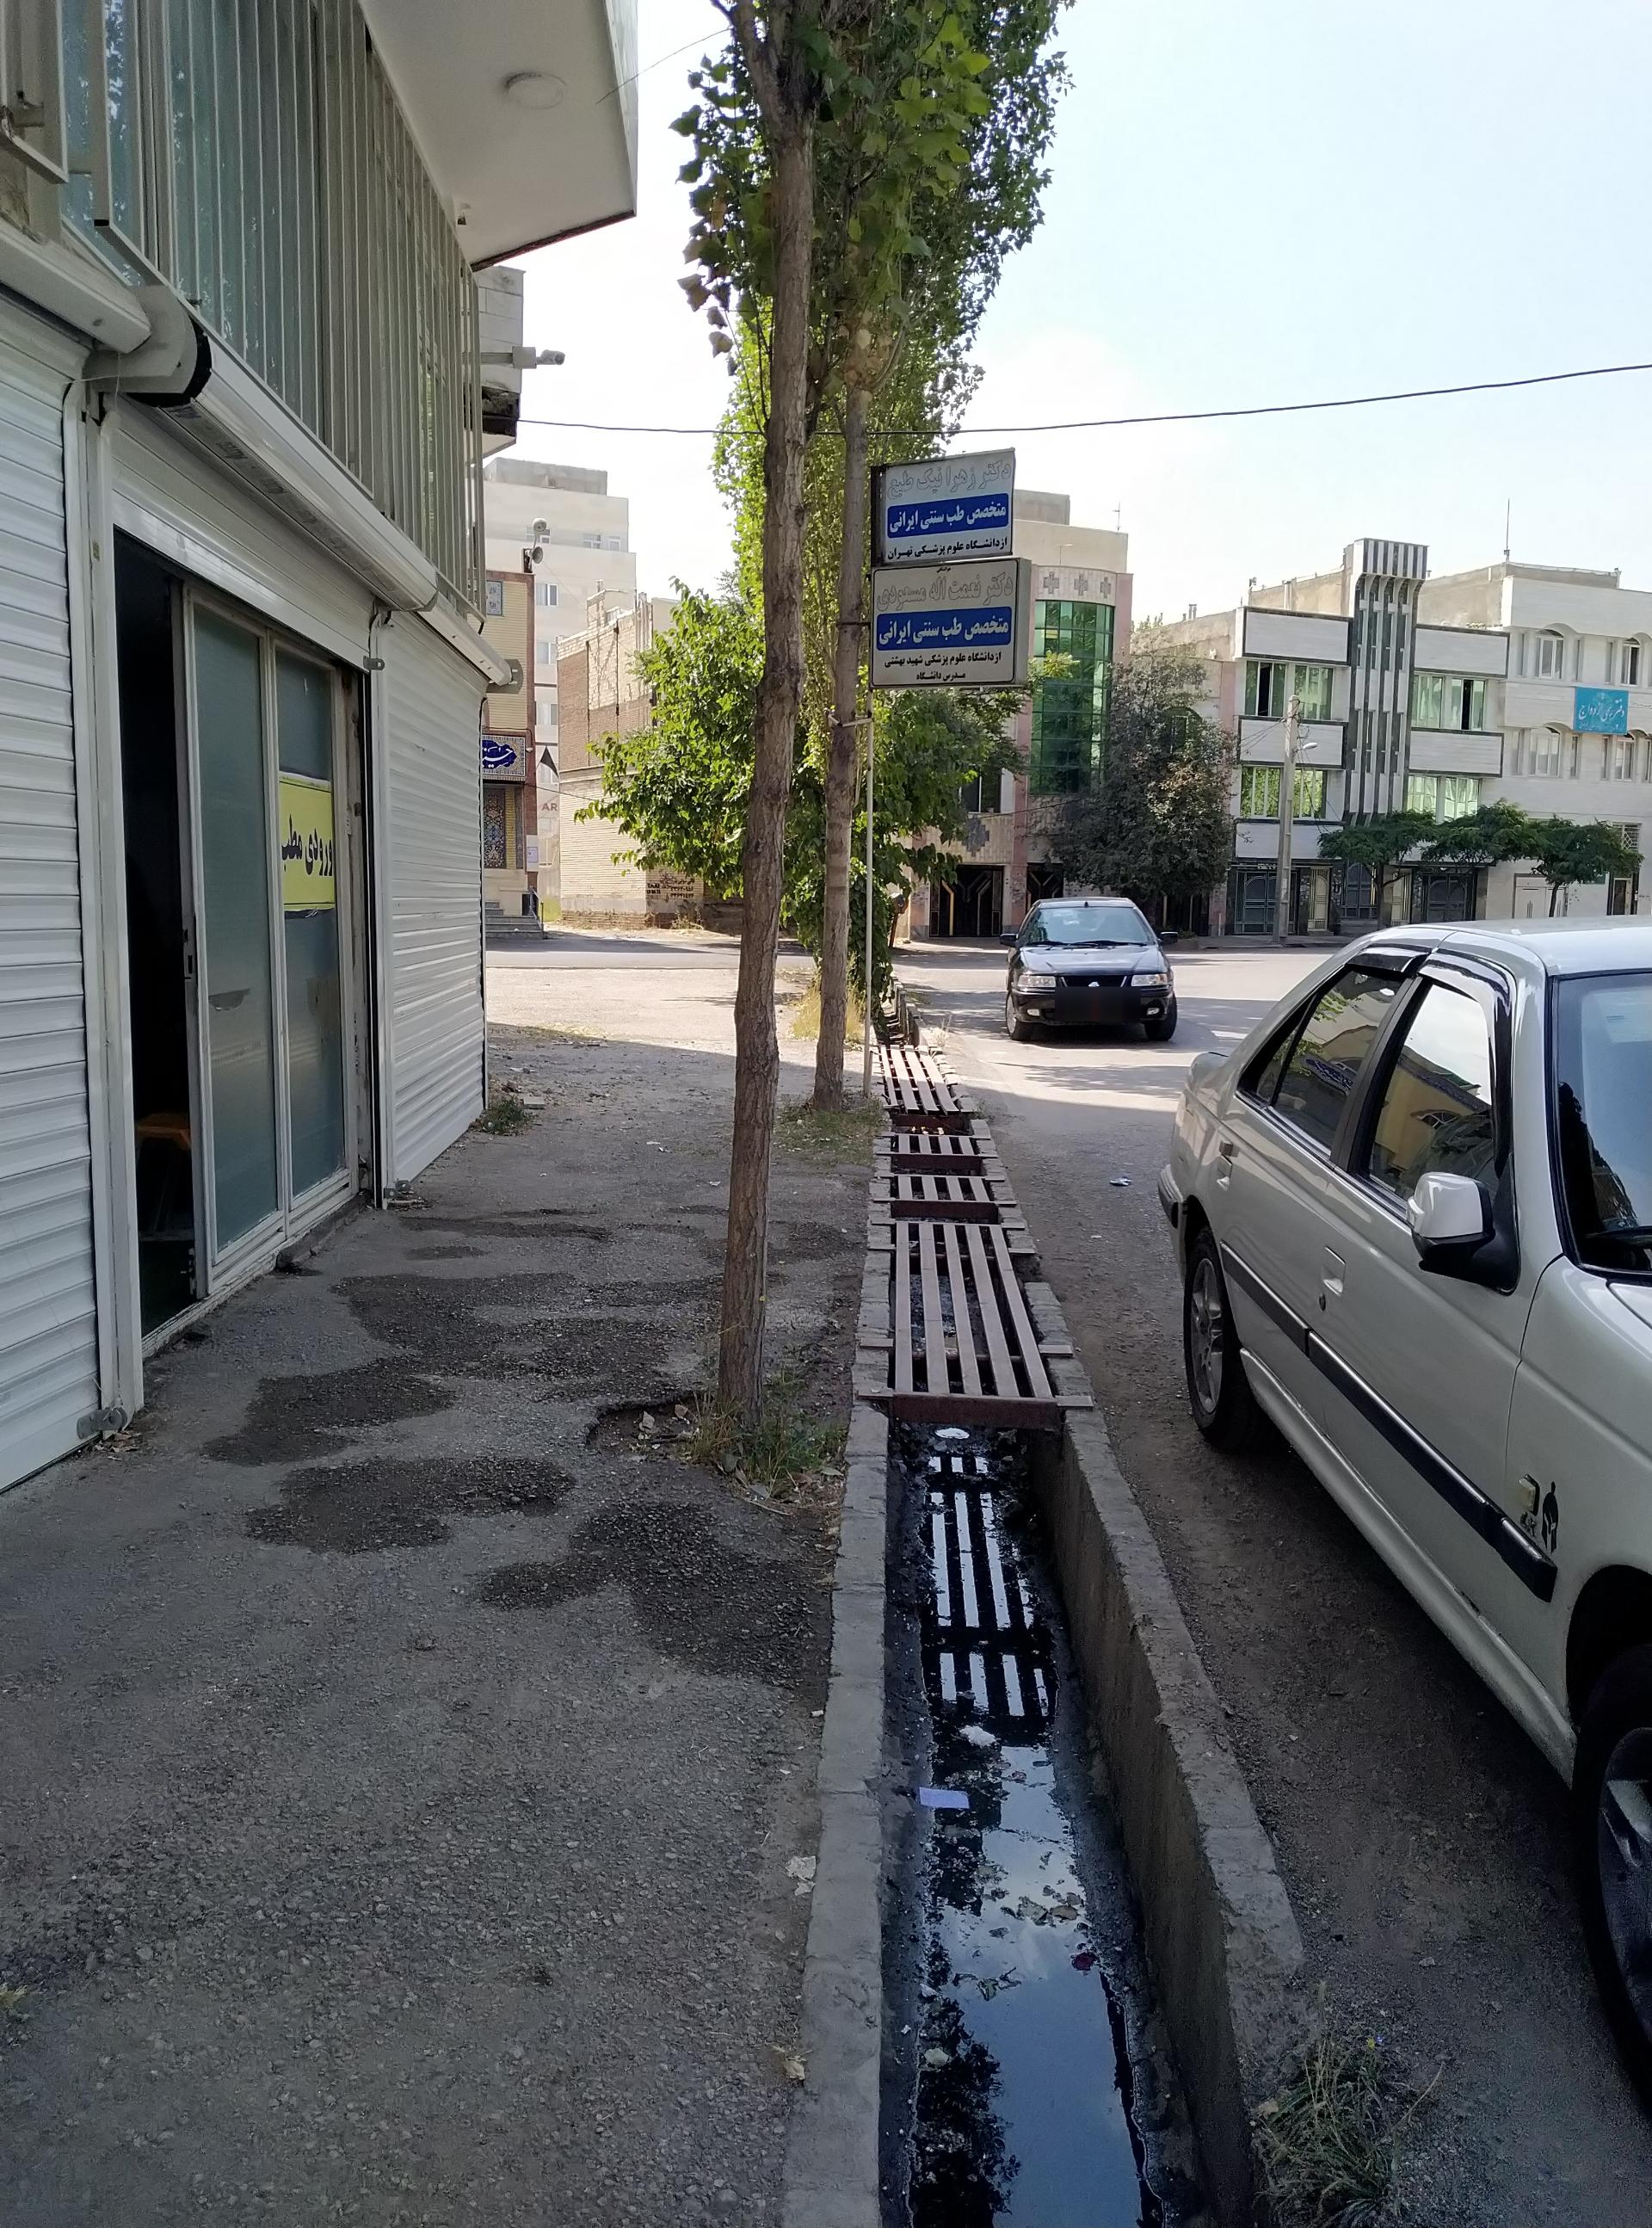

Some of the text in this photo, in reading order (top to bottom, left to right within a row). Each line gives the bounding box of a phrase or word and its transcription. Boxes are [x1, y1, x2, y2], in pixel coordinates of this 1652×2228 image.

[946, 466, 977, 493] زهرا
[978, 459, 1011, 489] دکتر
[889, 501, 1007, 534] متخصص طب سنتی ایرانی
[887, 546, 913, 560] تهران
[946, 541, 965, 555] علوم
[983, 571, 1014, 606] دکتر
[878, 614, 1009, 645] متخصص طب سنتی ایرانی
[884, 657, 905, 669] بهشتی
[906, 656, 923, 665] شهید
[949, 653, 966, 666] علوم
[915, 671, 941, 681] دانشگاه
[281, 814, 333, 877] ورودی مطب
